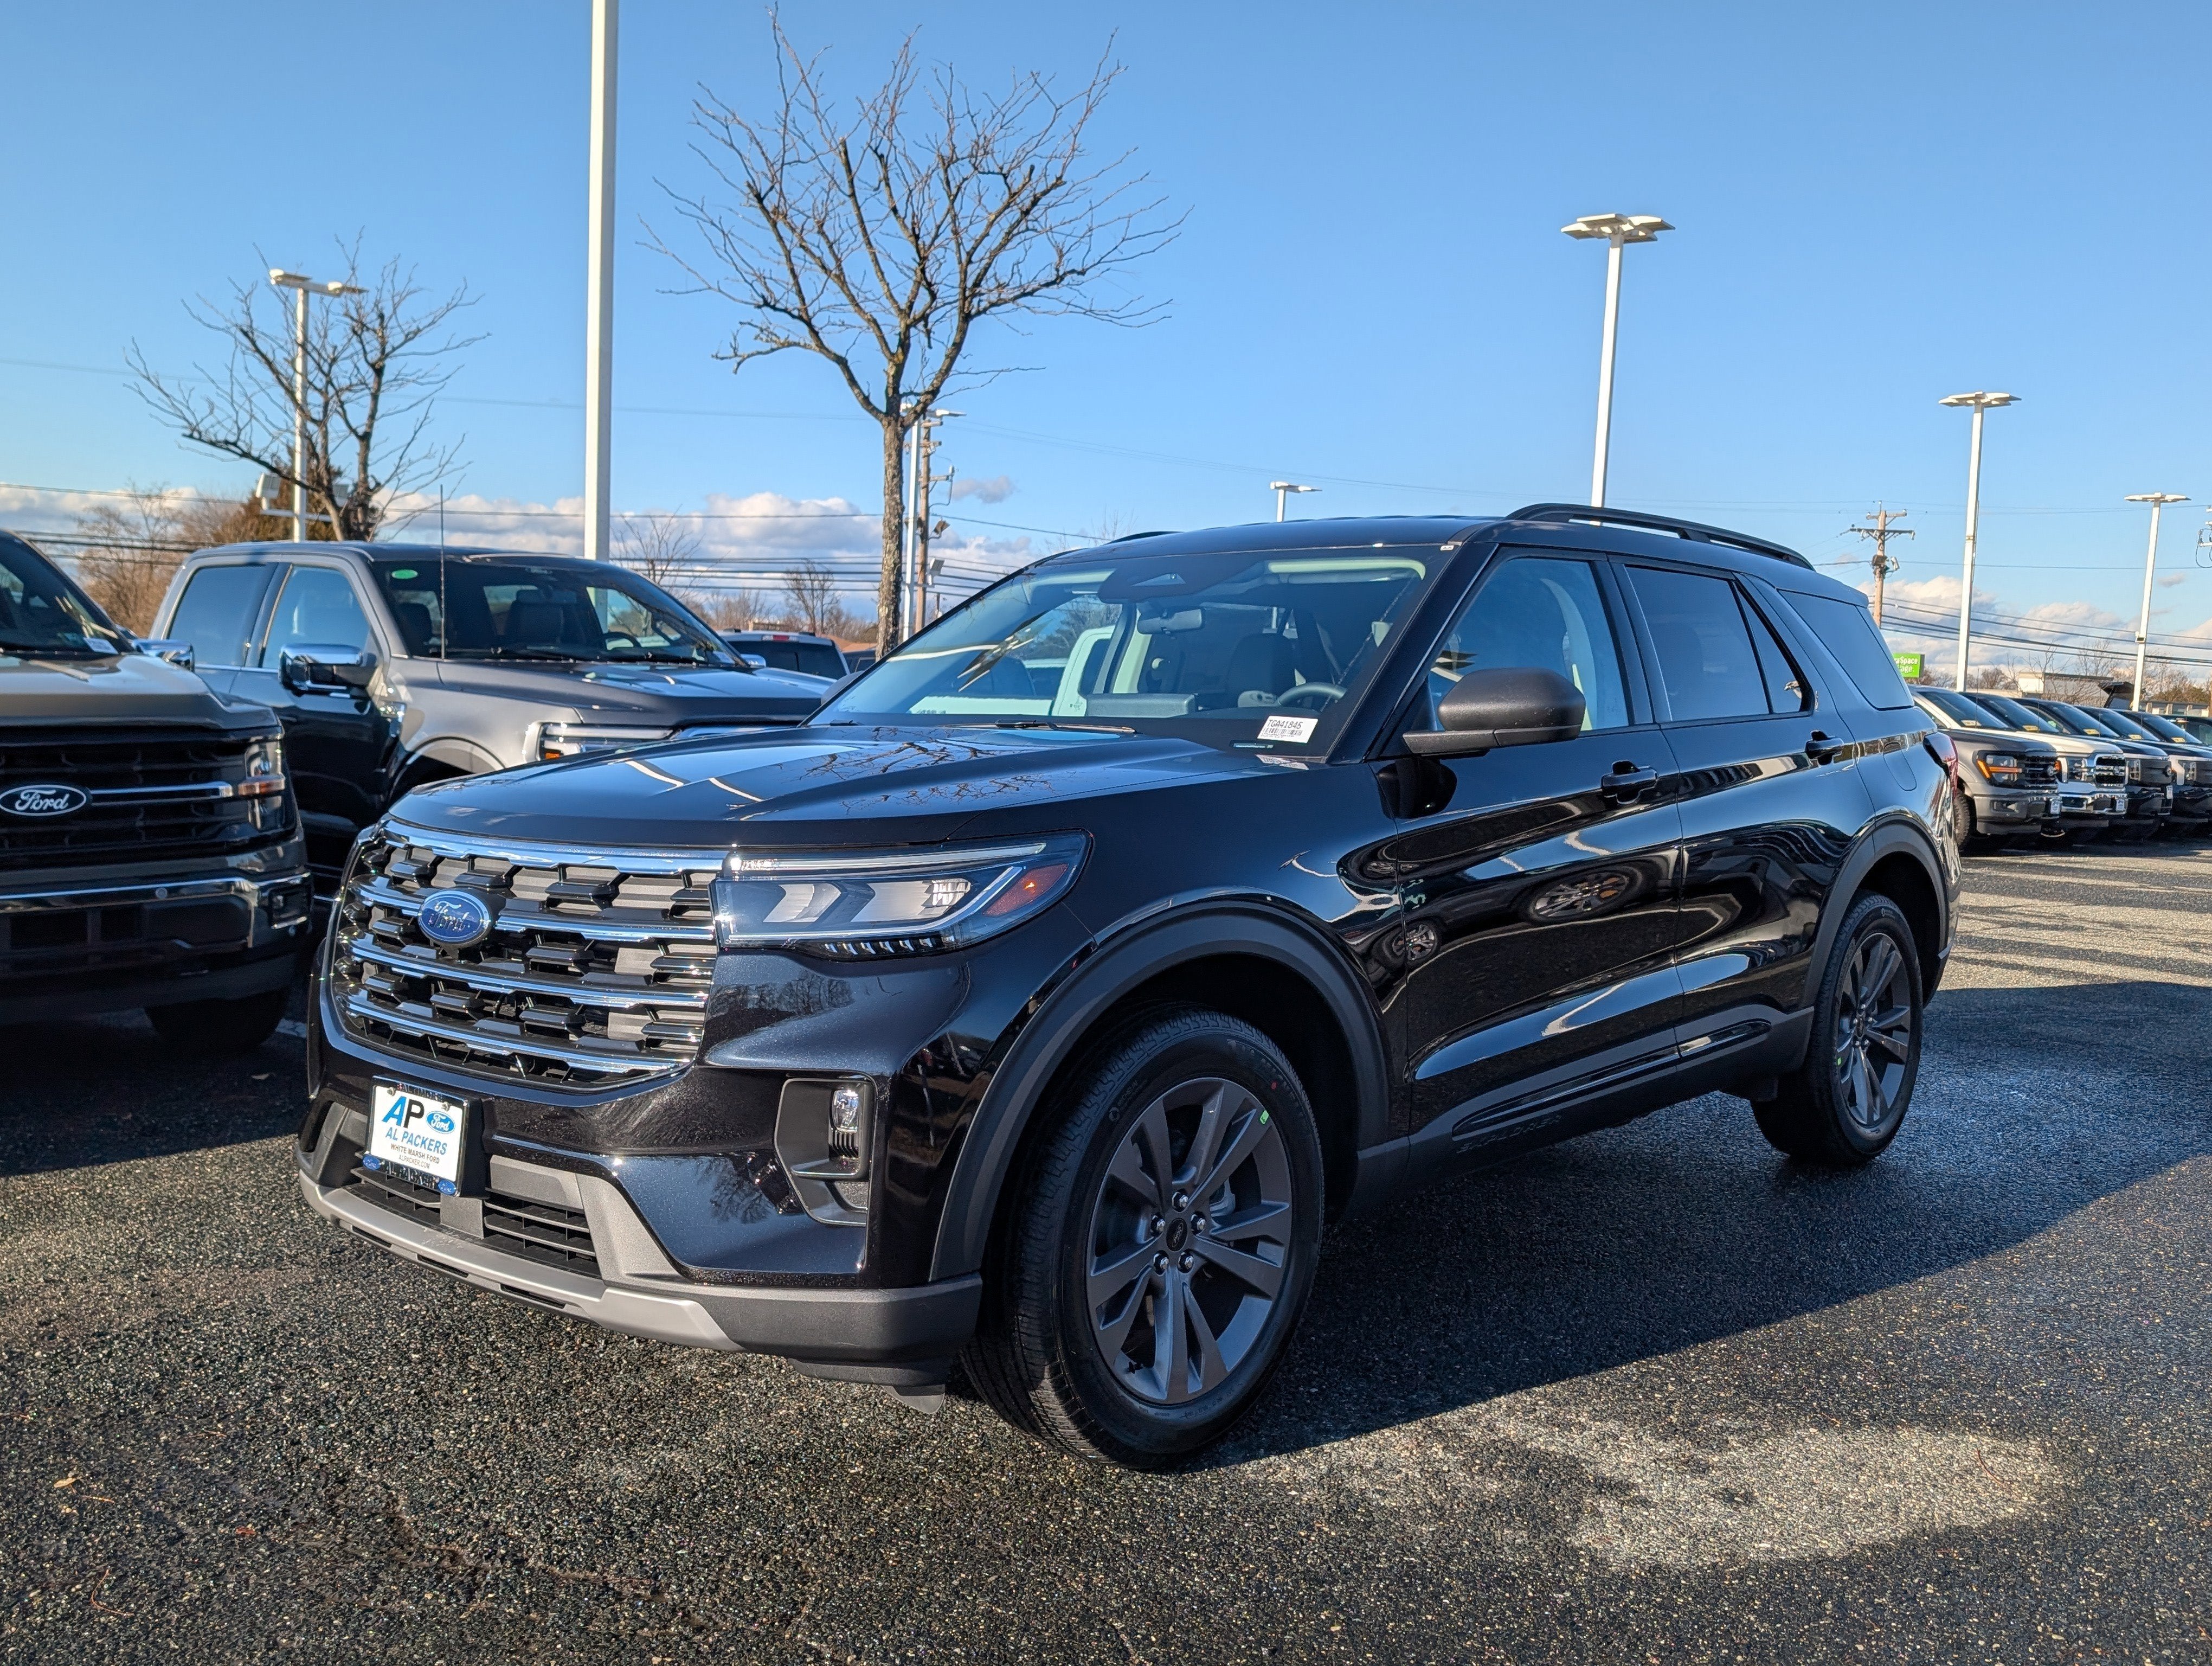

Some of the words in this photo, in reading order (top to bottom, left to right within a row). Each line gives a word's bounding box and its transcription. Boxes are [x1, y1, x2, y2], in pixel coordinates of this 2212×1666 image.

[1268, 719, 1303, 729] TGA41845
[15, 789, 70, 811] Ford
[382, 1096, 425, 1129] AP
[430, 1113, 451, 1132] Ford
[385, 1127, 398, 1141] AL
[401, 1131, 447, 1155] PACKERS
[391, 1143, 407, 1154] WHITE
[408, 1148, 426, 1159] MARSH
[427, 1154, 440, 1164] FORD
[398, 1155, 430, 1169] ALPACKER.COM
